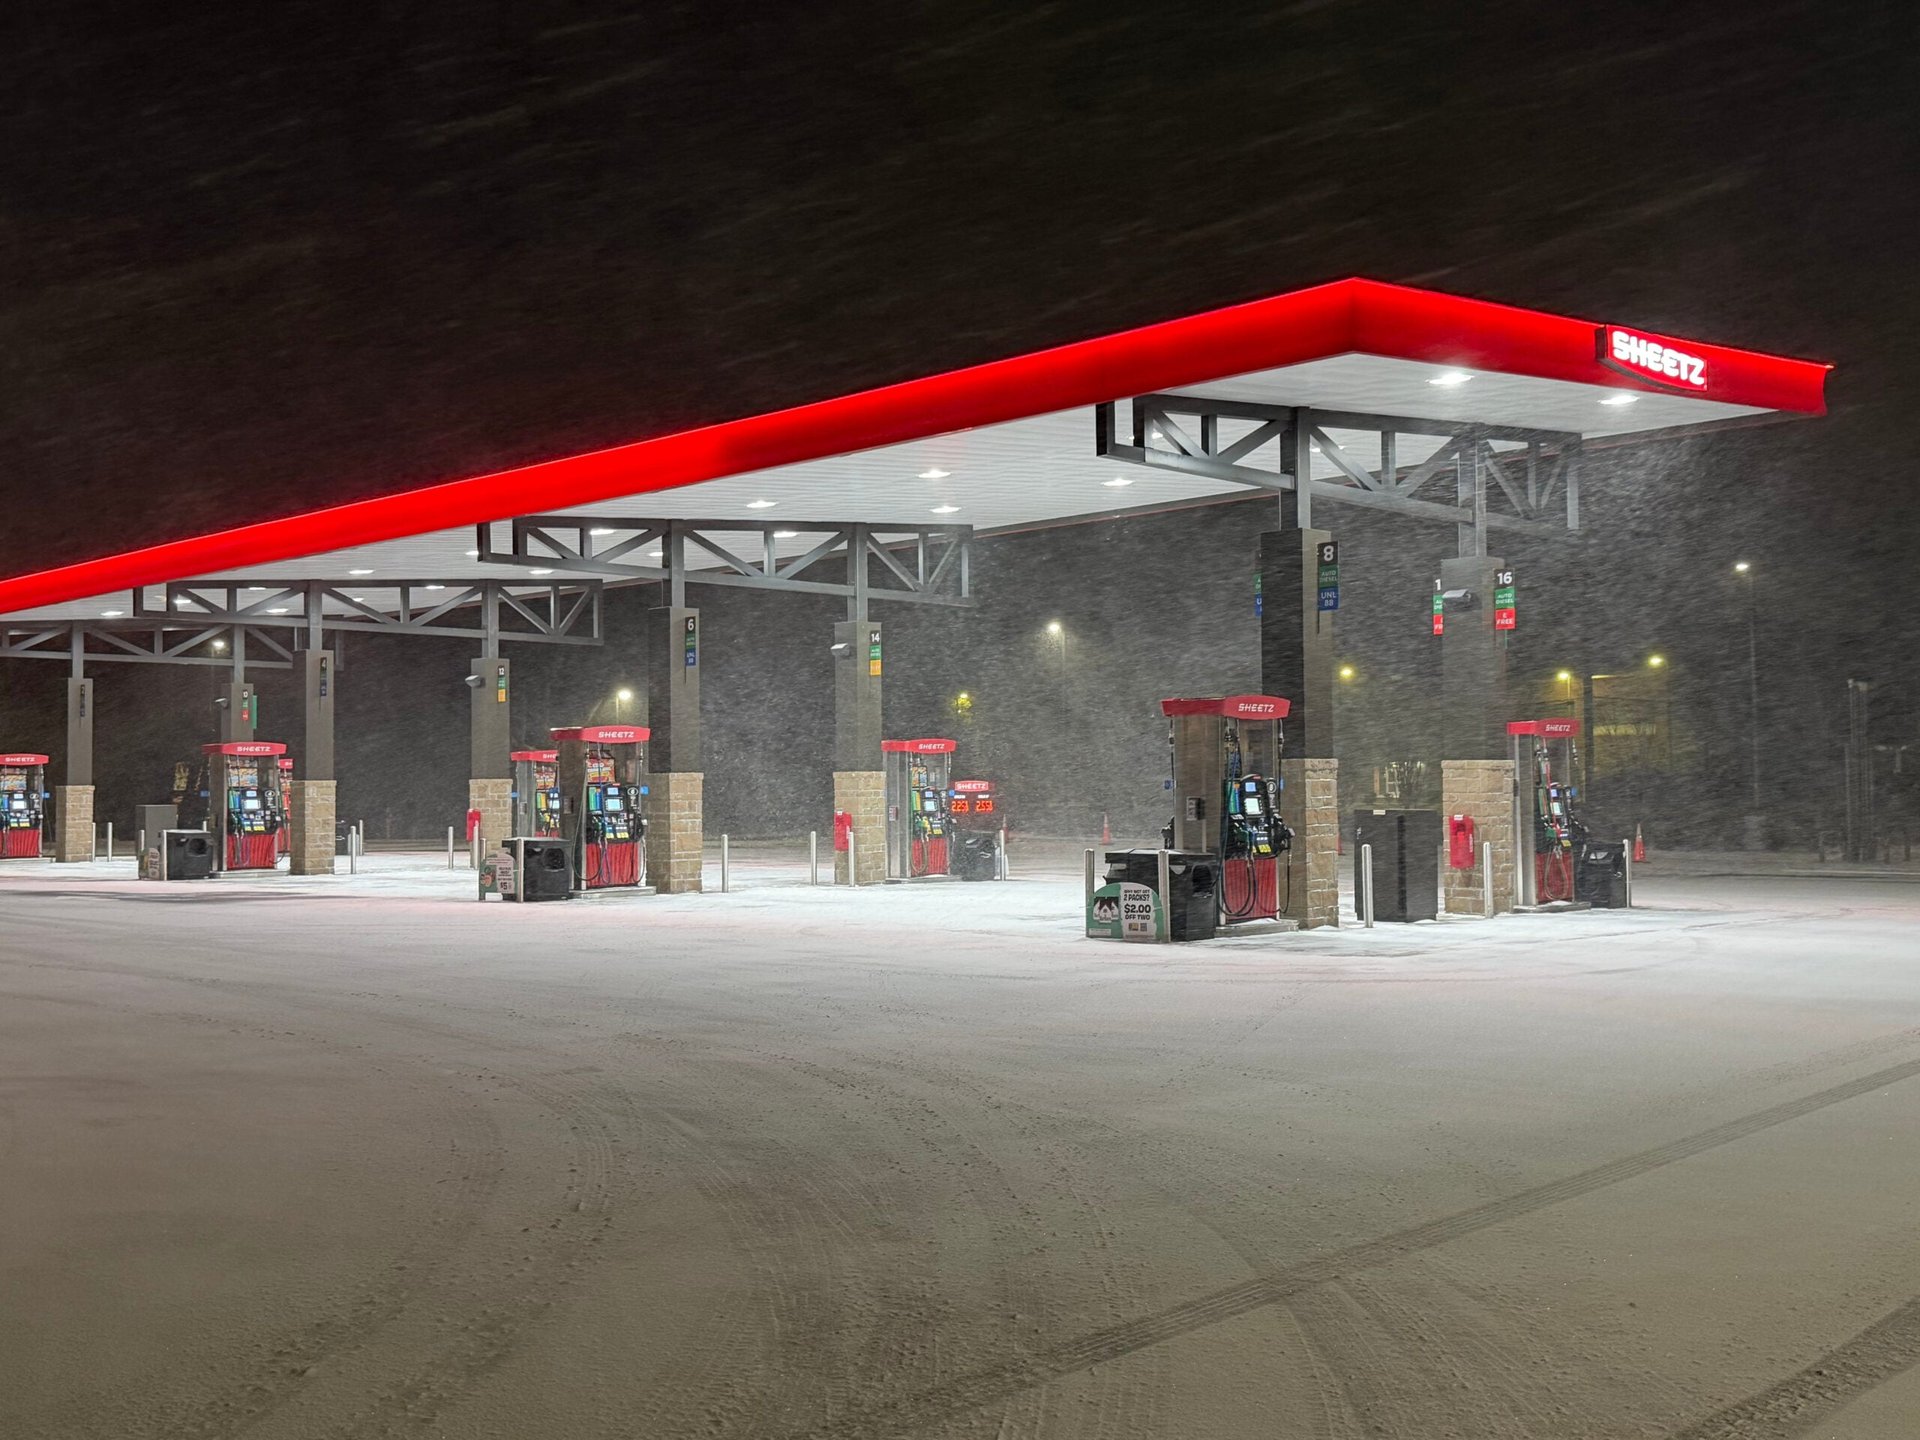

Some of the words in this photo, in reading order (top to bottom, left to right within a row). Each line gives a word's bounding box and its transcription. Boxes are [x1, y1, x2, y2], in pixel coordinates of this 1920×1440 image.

[1612, 330, 1705, 386] SHEETZ
[1323, 545, 1334, 562] 8
[1497, 572, 1513, 585] 16
[1434, 578, 1442, 591] 1
[1320, 591, 1336, 599] UNL
[687, 618, 695, 631] 6
[871, 632, 880, 643] 14
[498, 667, 505, 675] 12
[1238, 703, 1275, 713] SHEETZ
[1545, 724, 1571, 732] SHEETZ
[1124, 893, 1128, 901] 2
[1128, 893, 1150, 901] PACKS?
[1124, 903, 1151, 914] $2.00
